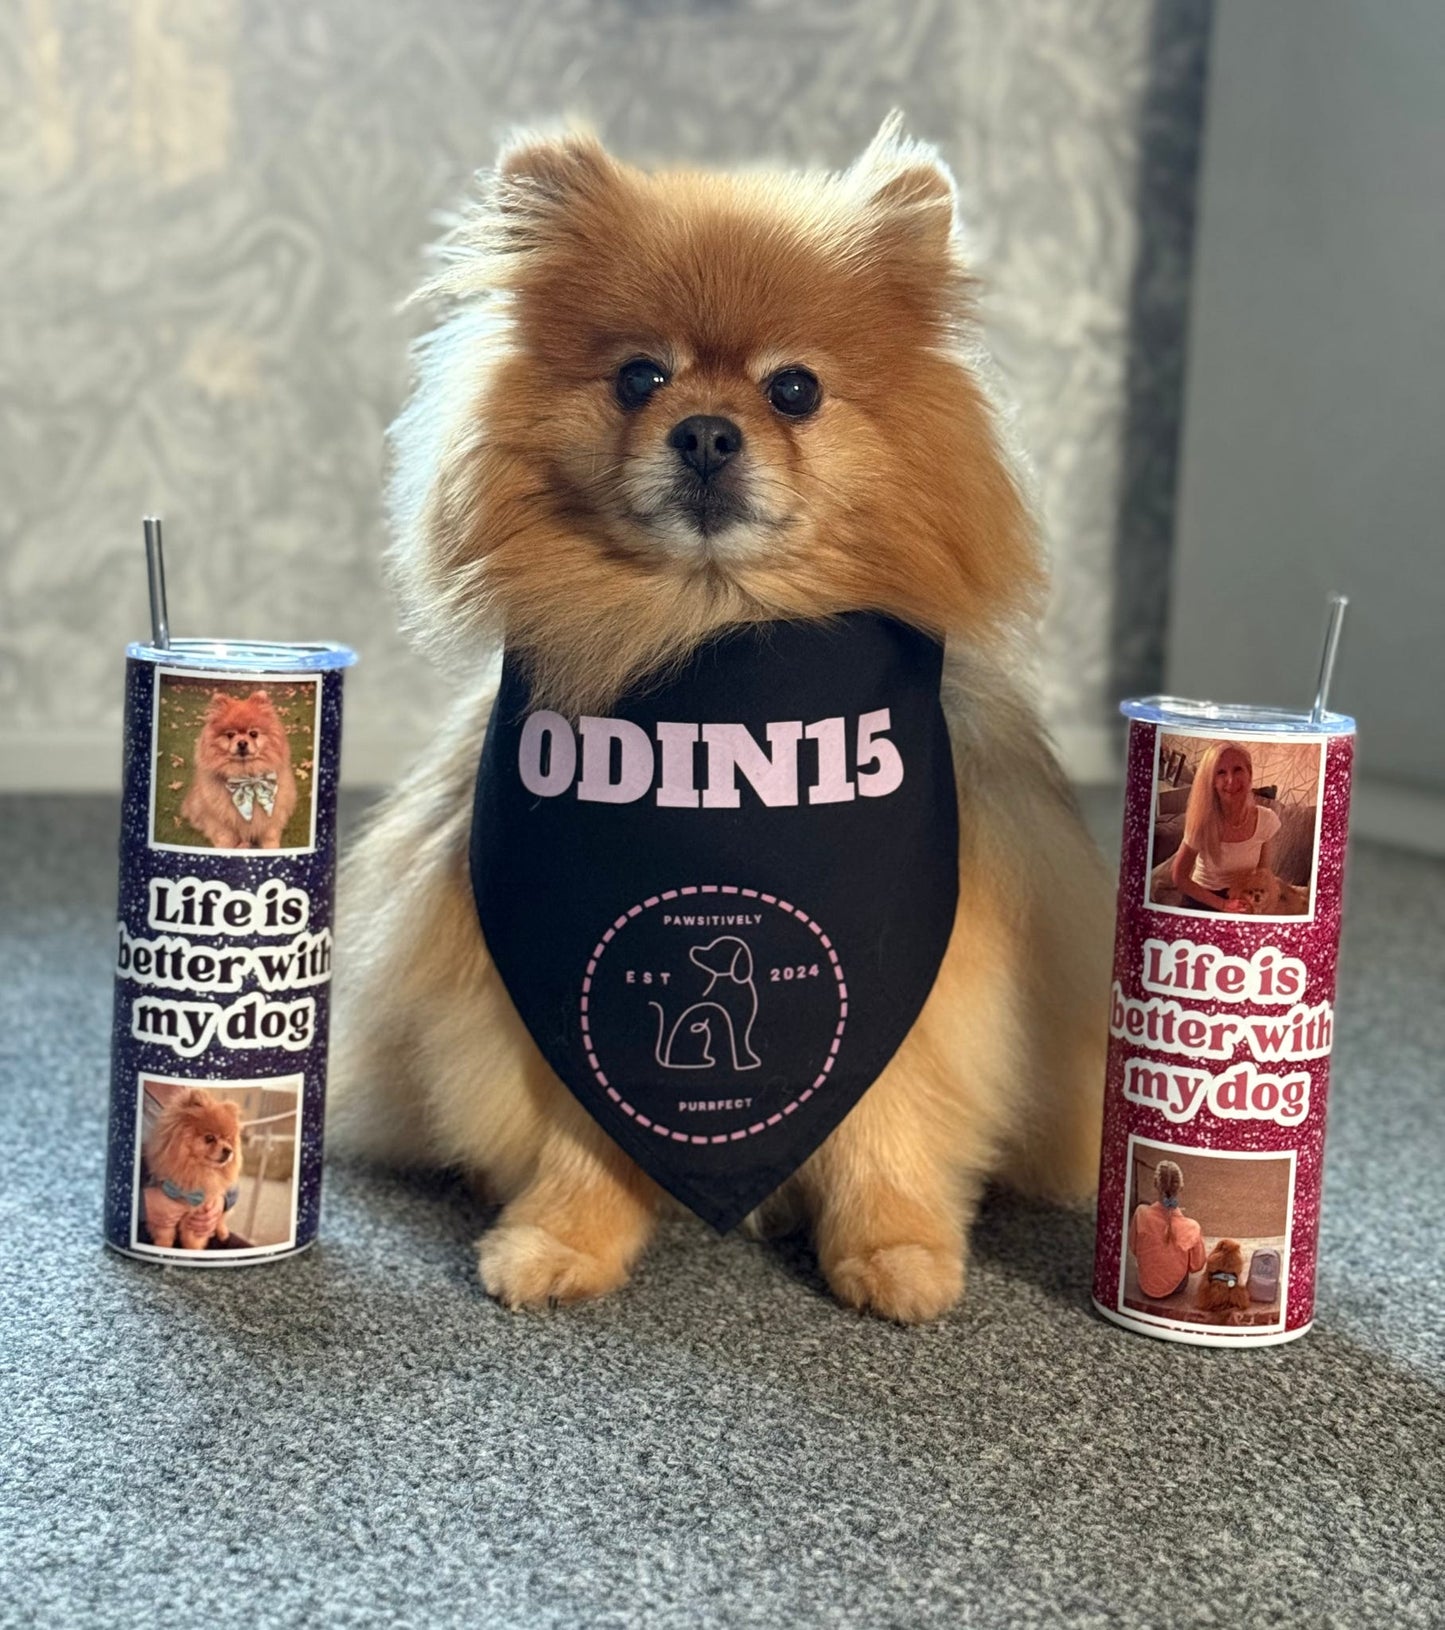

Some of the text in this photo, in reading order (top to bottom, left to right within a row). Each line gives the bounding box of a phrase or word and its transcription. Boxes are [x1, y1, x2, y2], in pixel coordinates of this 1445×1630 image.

[155, 886, 302, 927] Life is
[664, 914, 762, 926] PAWSITIVELY
[118, 930, 331, 983] better with
[770, 964, 819, 982] 2024
[1148, 948, 1299, 995] Life is
[138, 1001, 310, 1048] my dog
[1111, 988, 1331, 1053] better with
[679, 1098, 752, 1112] PURRFECT
[1129, 1066, 1305, 1117] my dog
